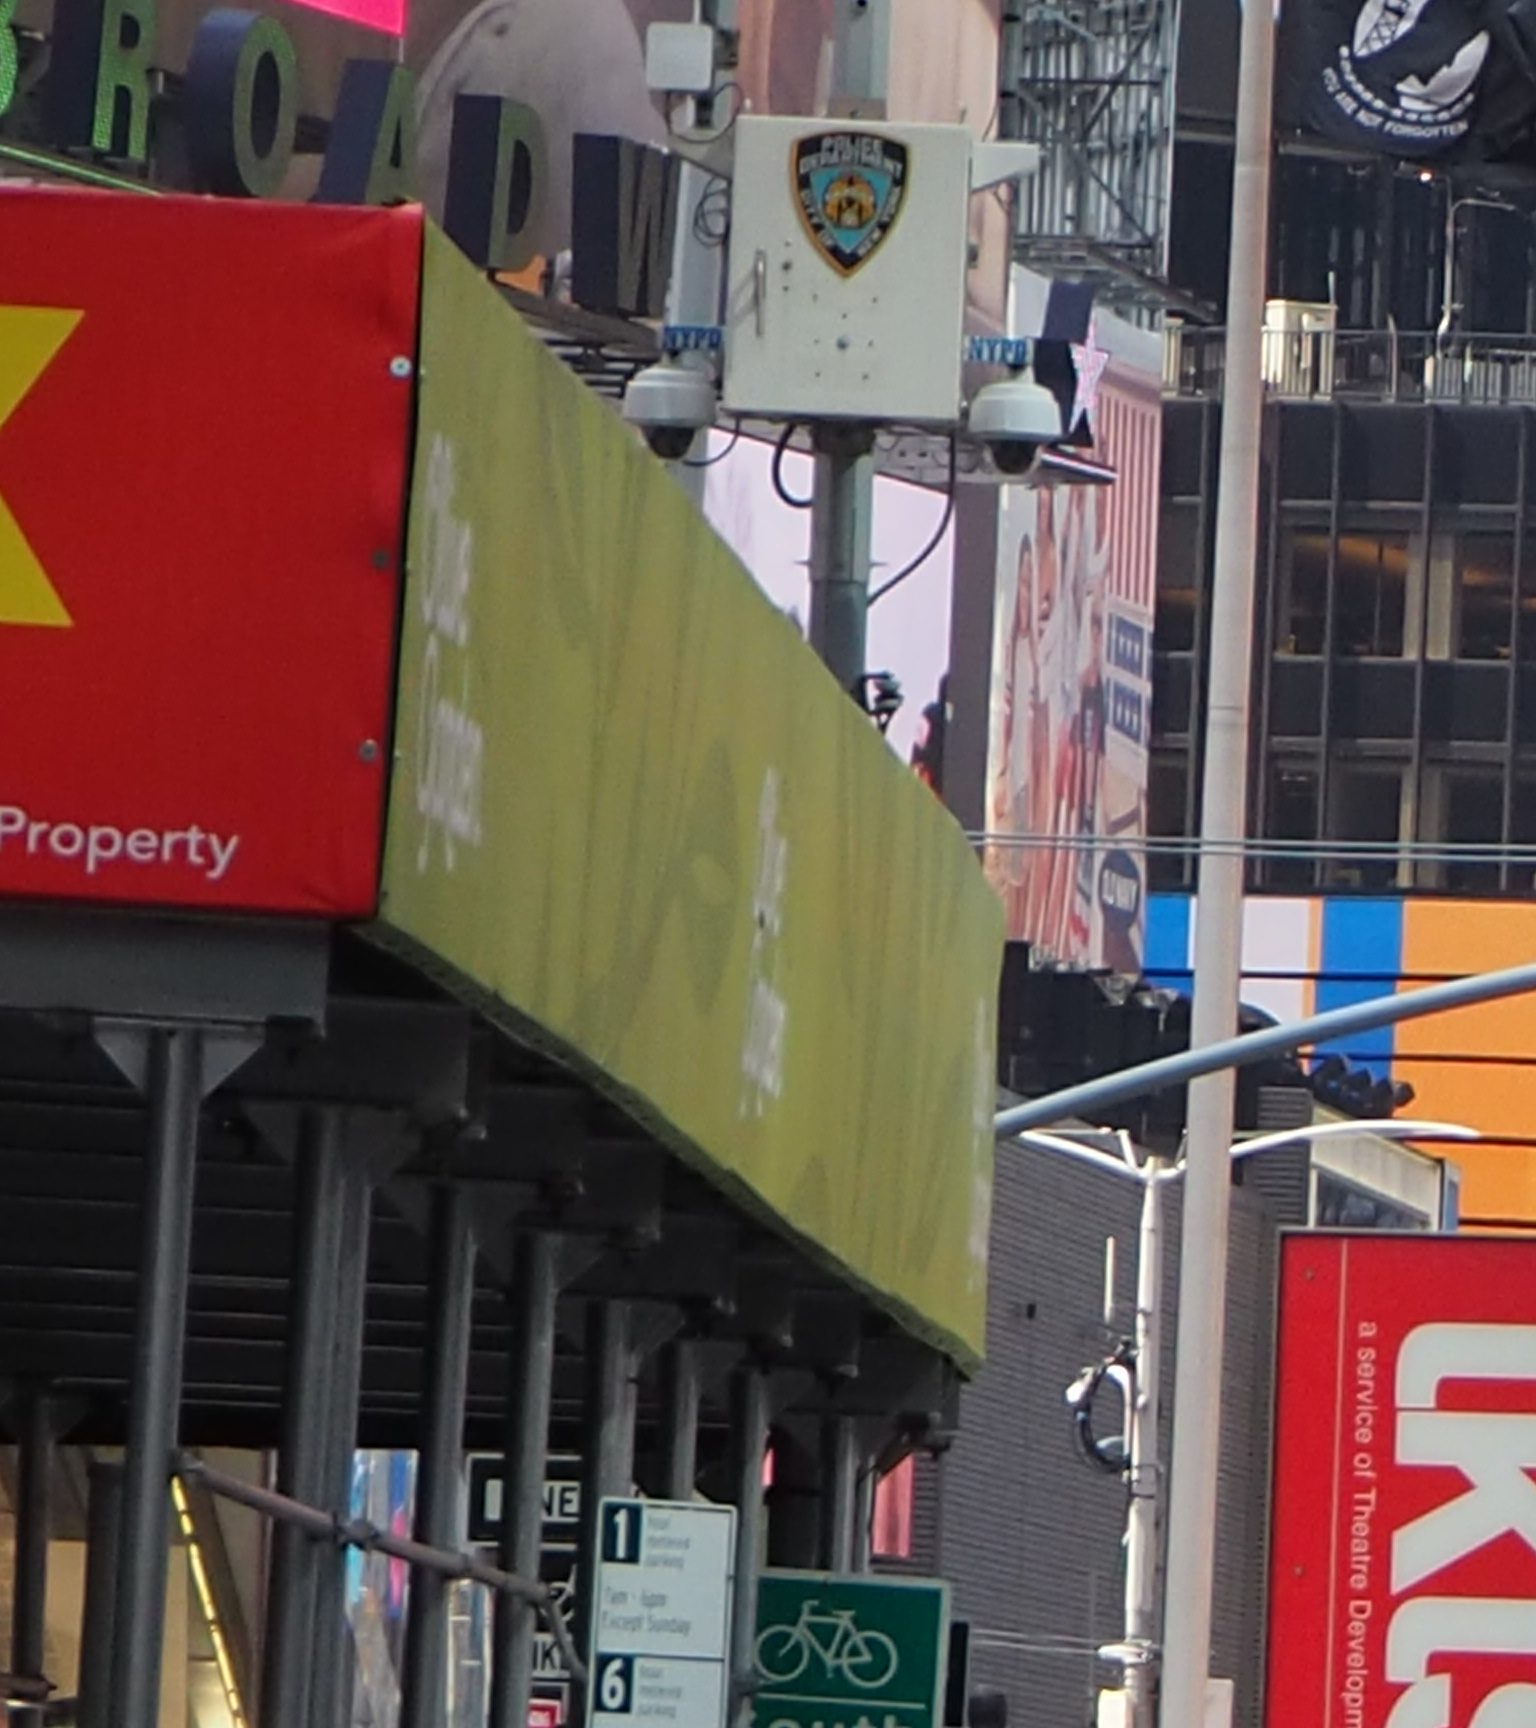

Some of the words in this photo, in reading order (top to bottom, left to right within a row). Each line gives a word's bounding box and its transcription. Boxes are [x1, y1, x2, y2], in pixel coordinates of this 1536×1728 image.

[1383, 119, 1470, 138] FORGOTTEN
[664, 326, 723, 351] NYPD
[967, 338, 1027, 364] NYPD
[0, 806, 239, 880] Property
[1358, 1321, 1377, 1337] a
[1353, 1347, 1377, 1445] service
[1351, 1452, 1375, 1480] of
[613, 1509, 628, 1560] 1
[1348, 1487, 1376, 1590] Theatre
[647, 1614, 692, 1637] Sunday
[600, 1658, 626, 1709] 6
